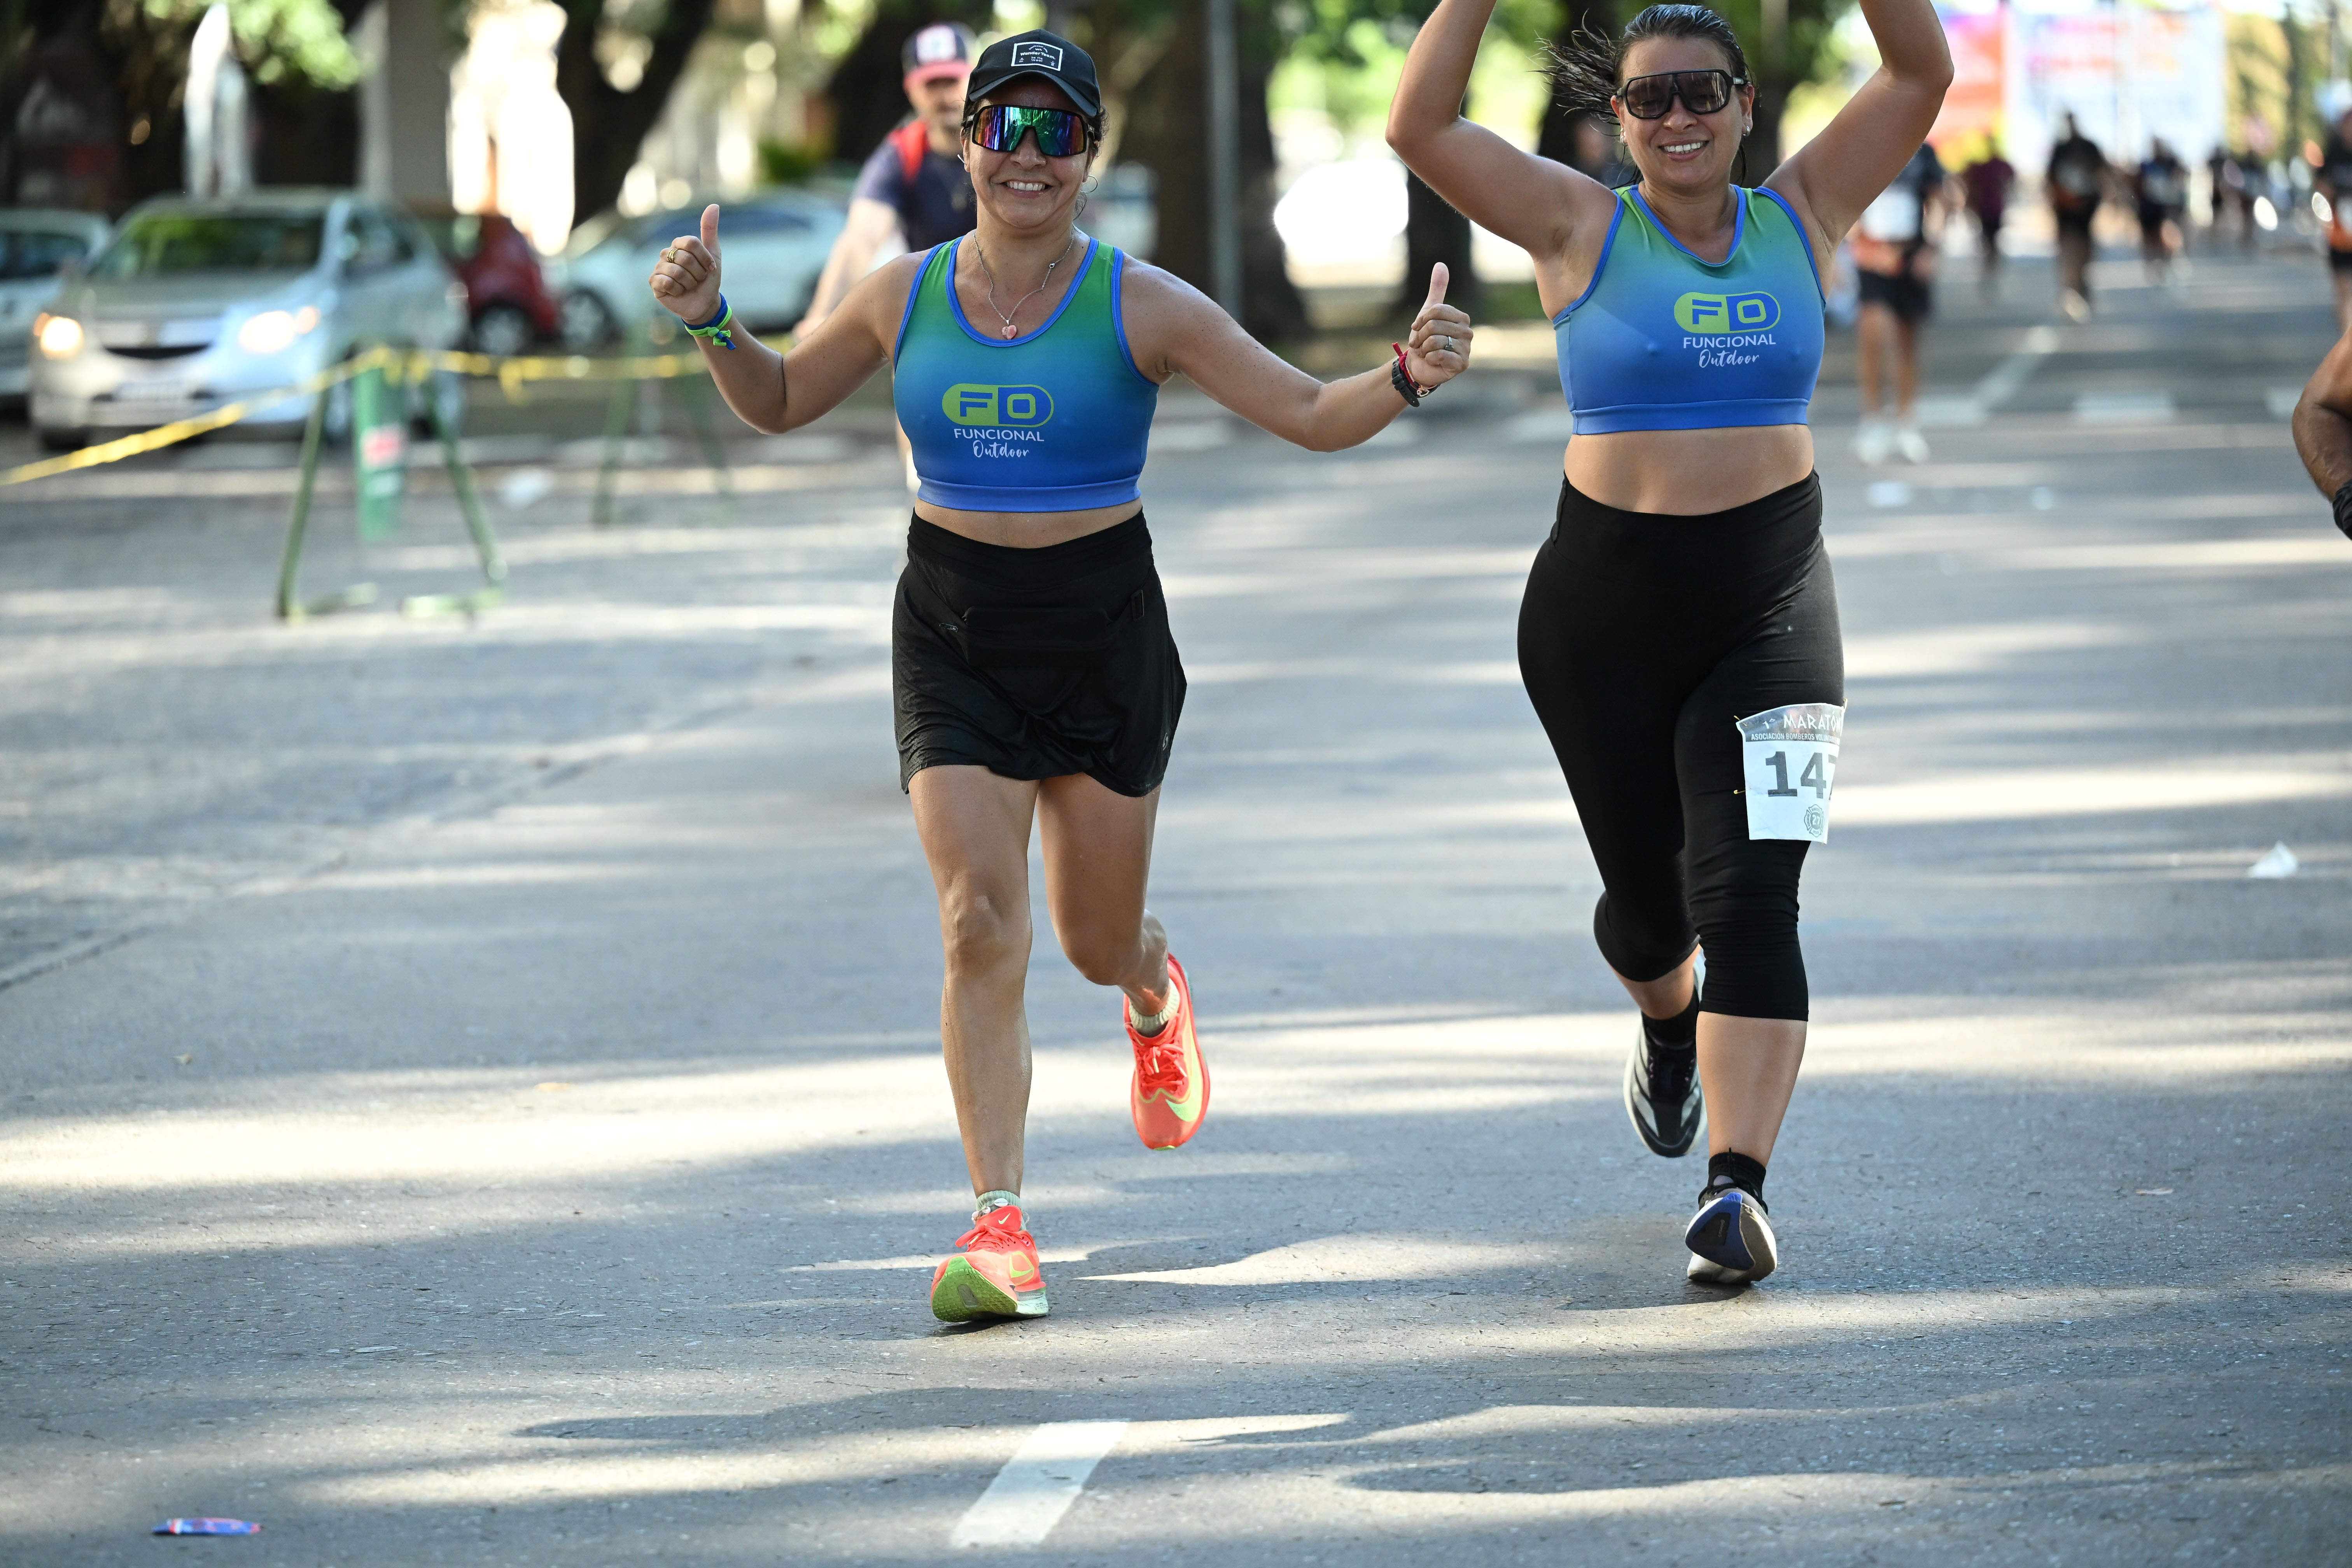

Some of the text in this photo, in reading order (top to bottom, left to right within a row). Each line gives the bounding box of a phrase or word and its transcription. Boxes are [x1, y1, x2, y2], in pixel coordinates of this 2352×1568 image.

[1683, 334, 1776, 348] FUNCIONAL
[1699, 349, 1759, 368] Outdoor
[954, 428, 1045, 441] FUNCIONAL
[973, 440, 1030, 458] Outdoor
[1751, 732, 1785, 740] ASOCIACIÓN
[1812, 814, 1821, 825] 27
